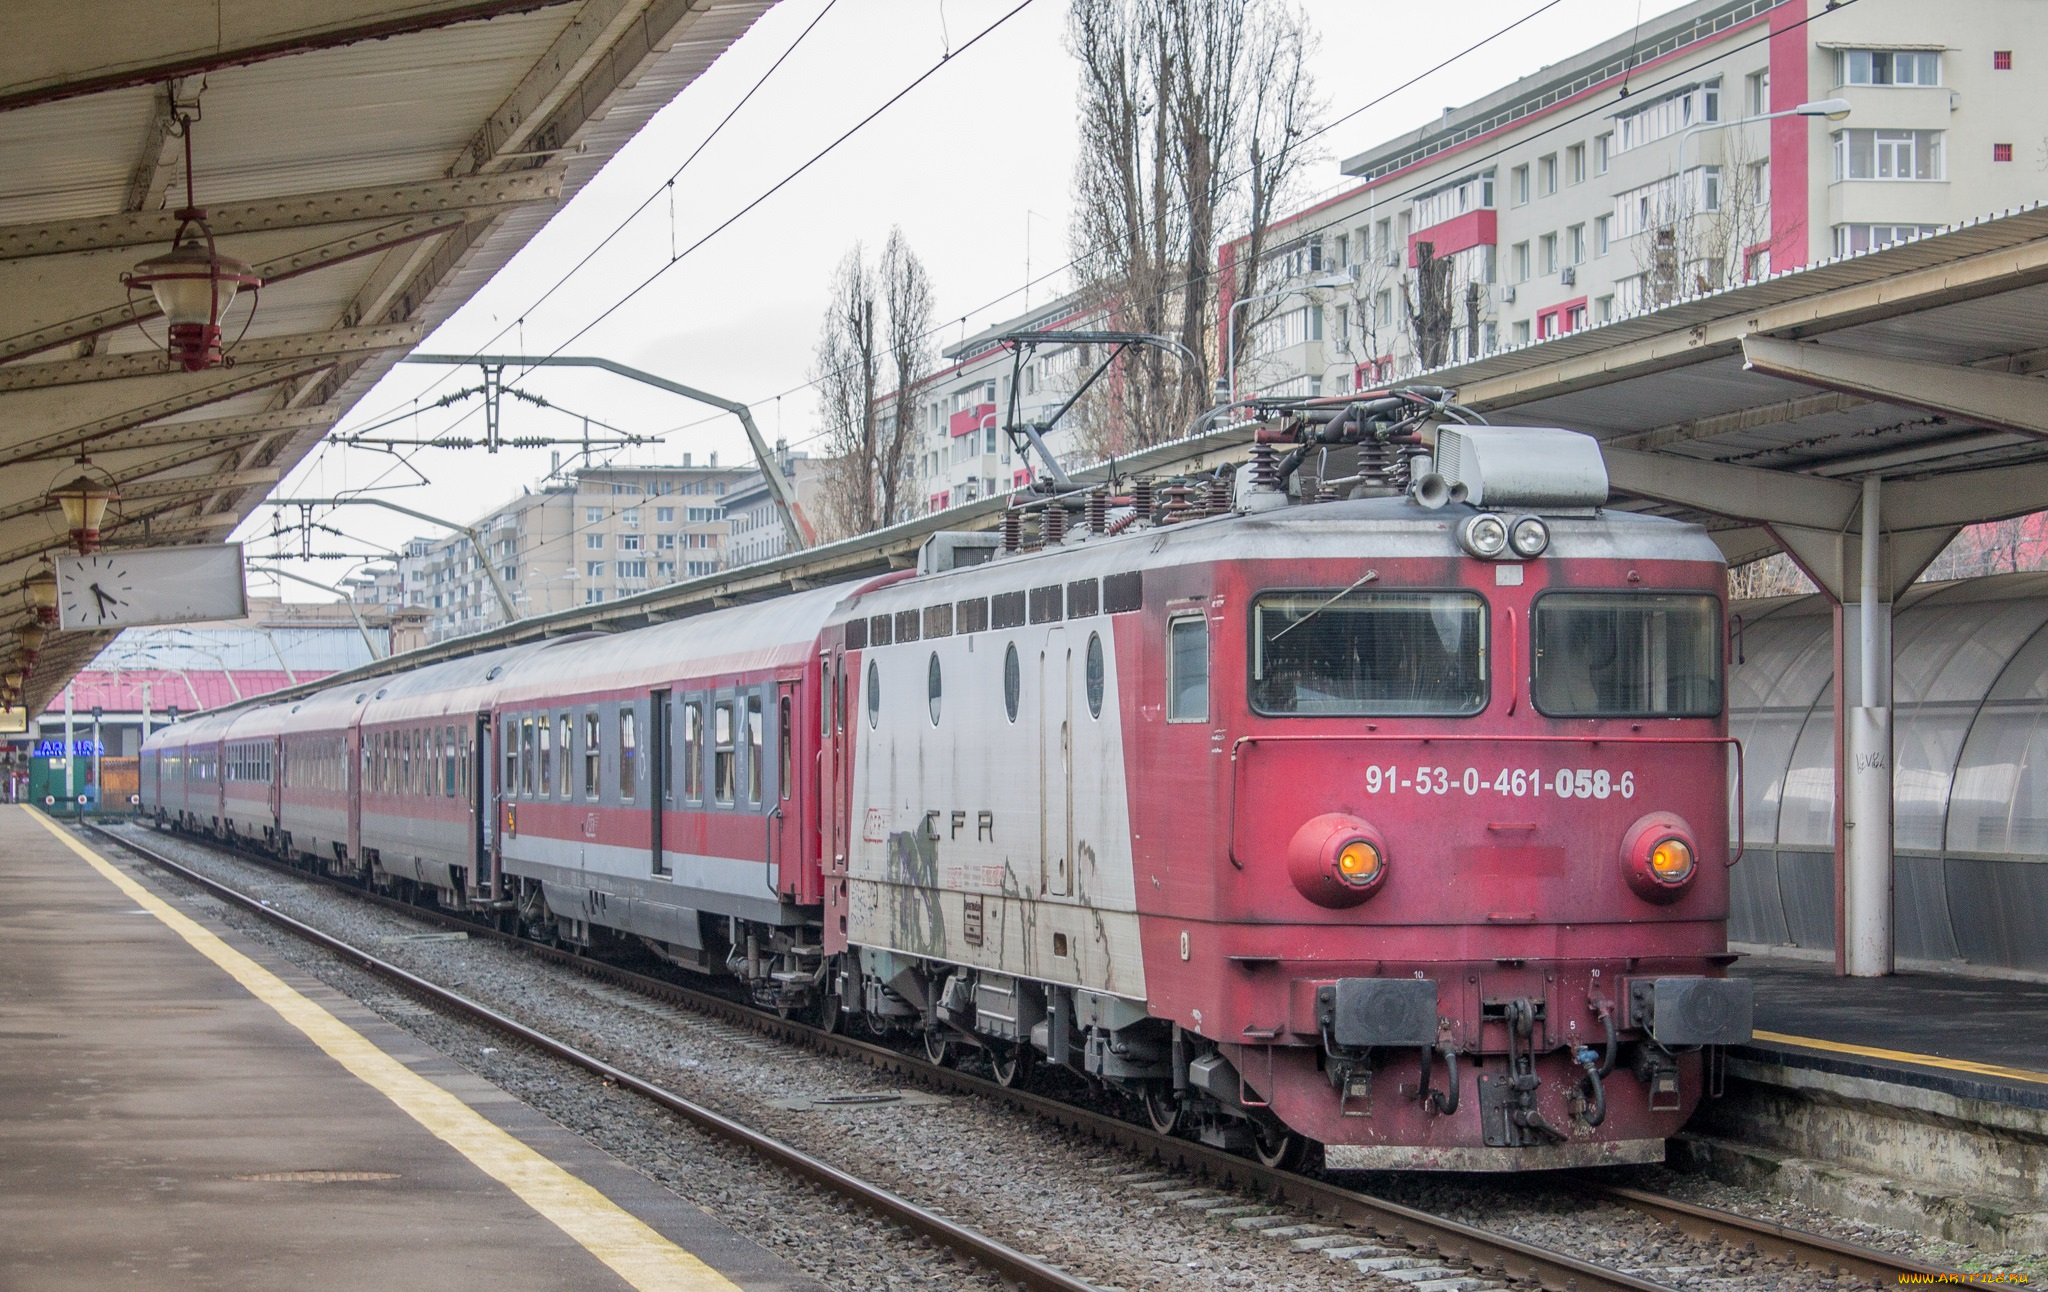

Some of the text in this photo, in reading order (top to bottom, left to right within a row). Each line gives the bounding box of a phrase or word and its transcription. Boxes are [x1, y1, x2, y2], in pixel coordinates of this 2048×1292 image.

[1366, 765, 1635, 799] 91-53-0-461-058-6
[1413, 970, 1424, 979] 10
[1591, 968, 1600, 977] 10
[1569, 1021, 1576, 1030] 5
